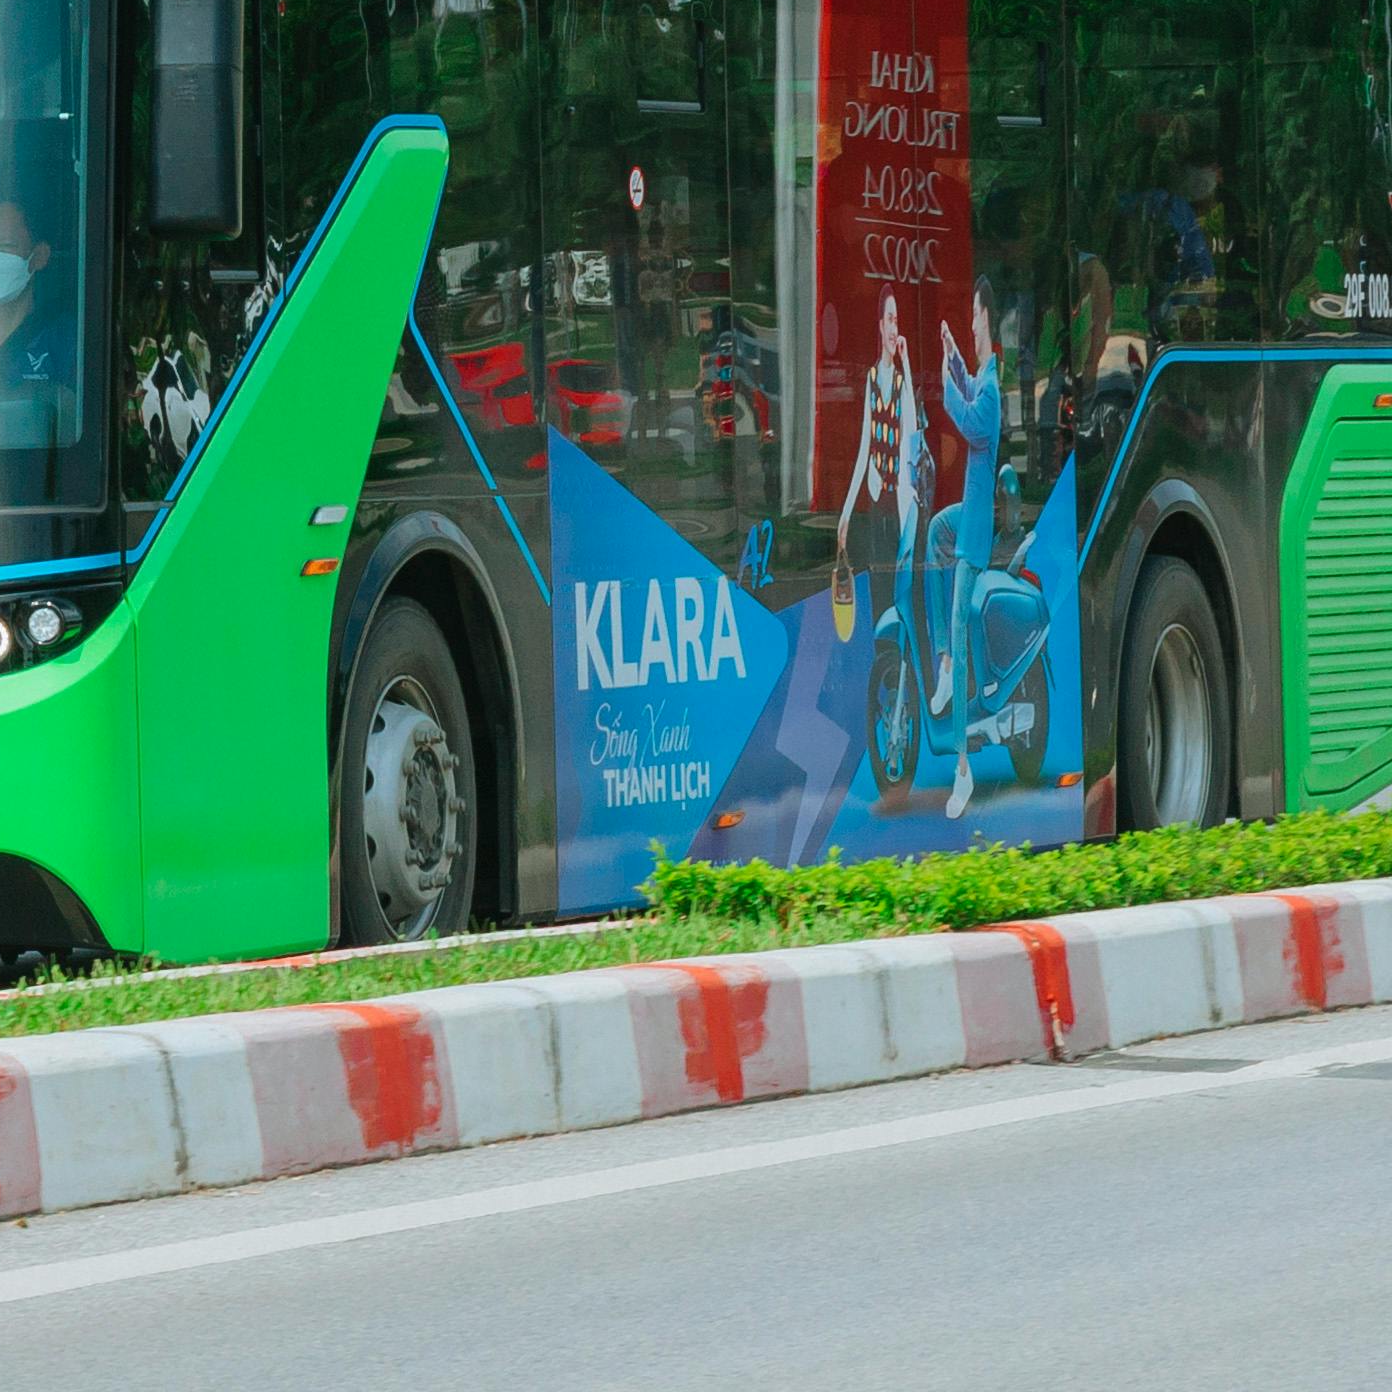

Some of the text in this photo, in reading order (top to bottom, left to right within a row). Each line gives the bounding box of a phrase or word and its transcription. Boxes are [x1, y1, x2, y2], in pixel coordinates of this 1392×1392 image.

[1343, 273, 1366, 318] 29F
[574, 575, 747, 691] KLARA
[639, 699, 691, 768] Xanh
[603, 761, 711, 811] THANH LỊCH
